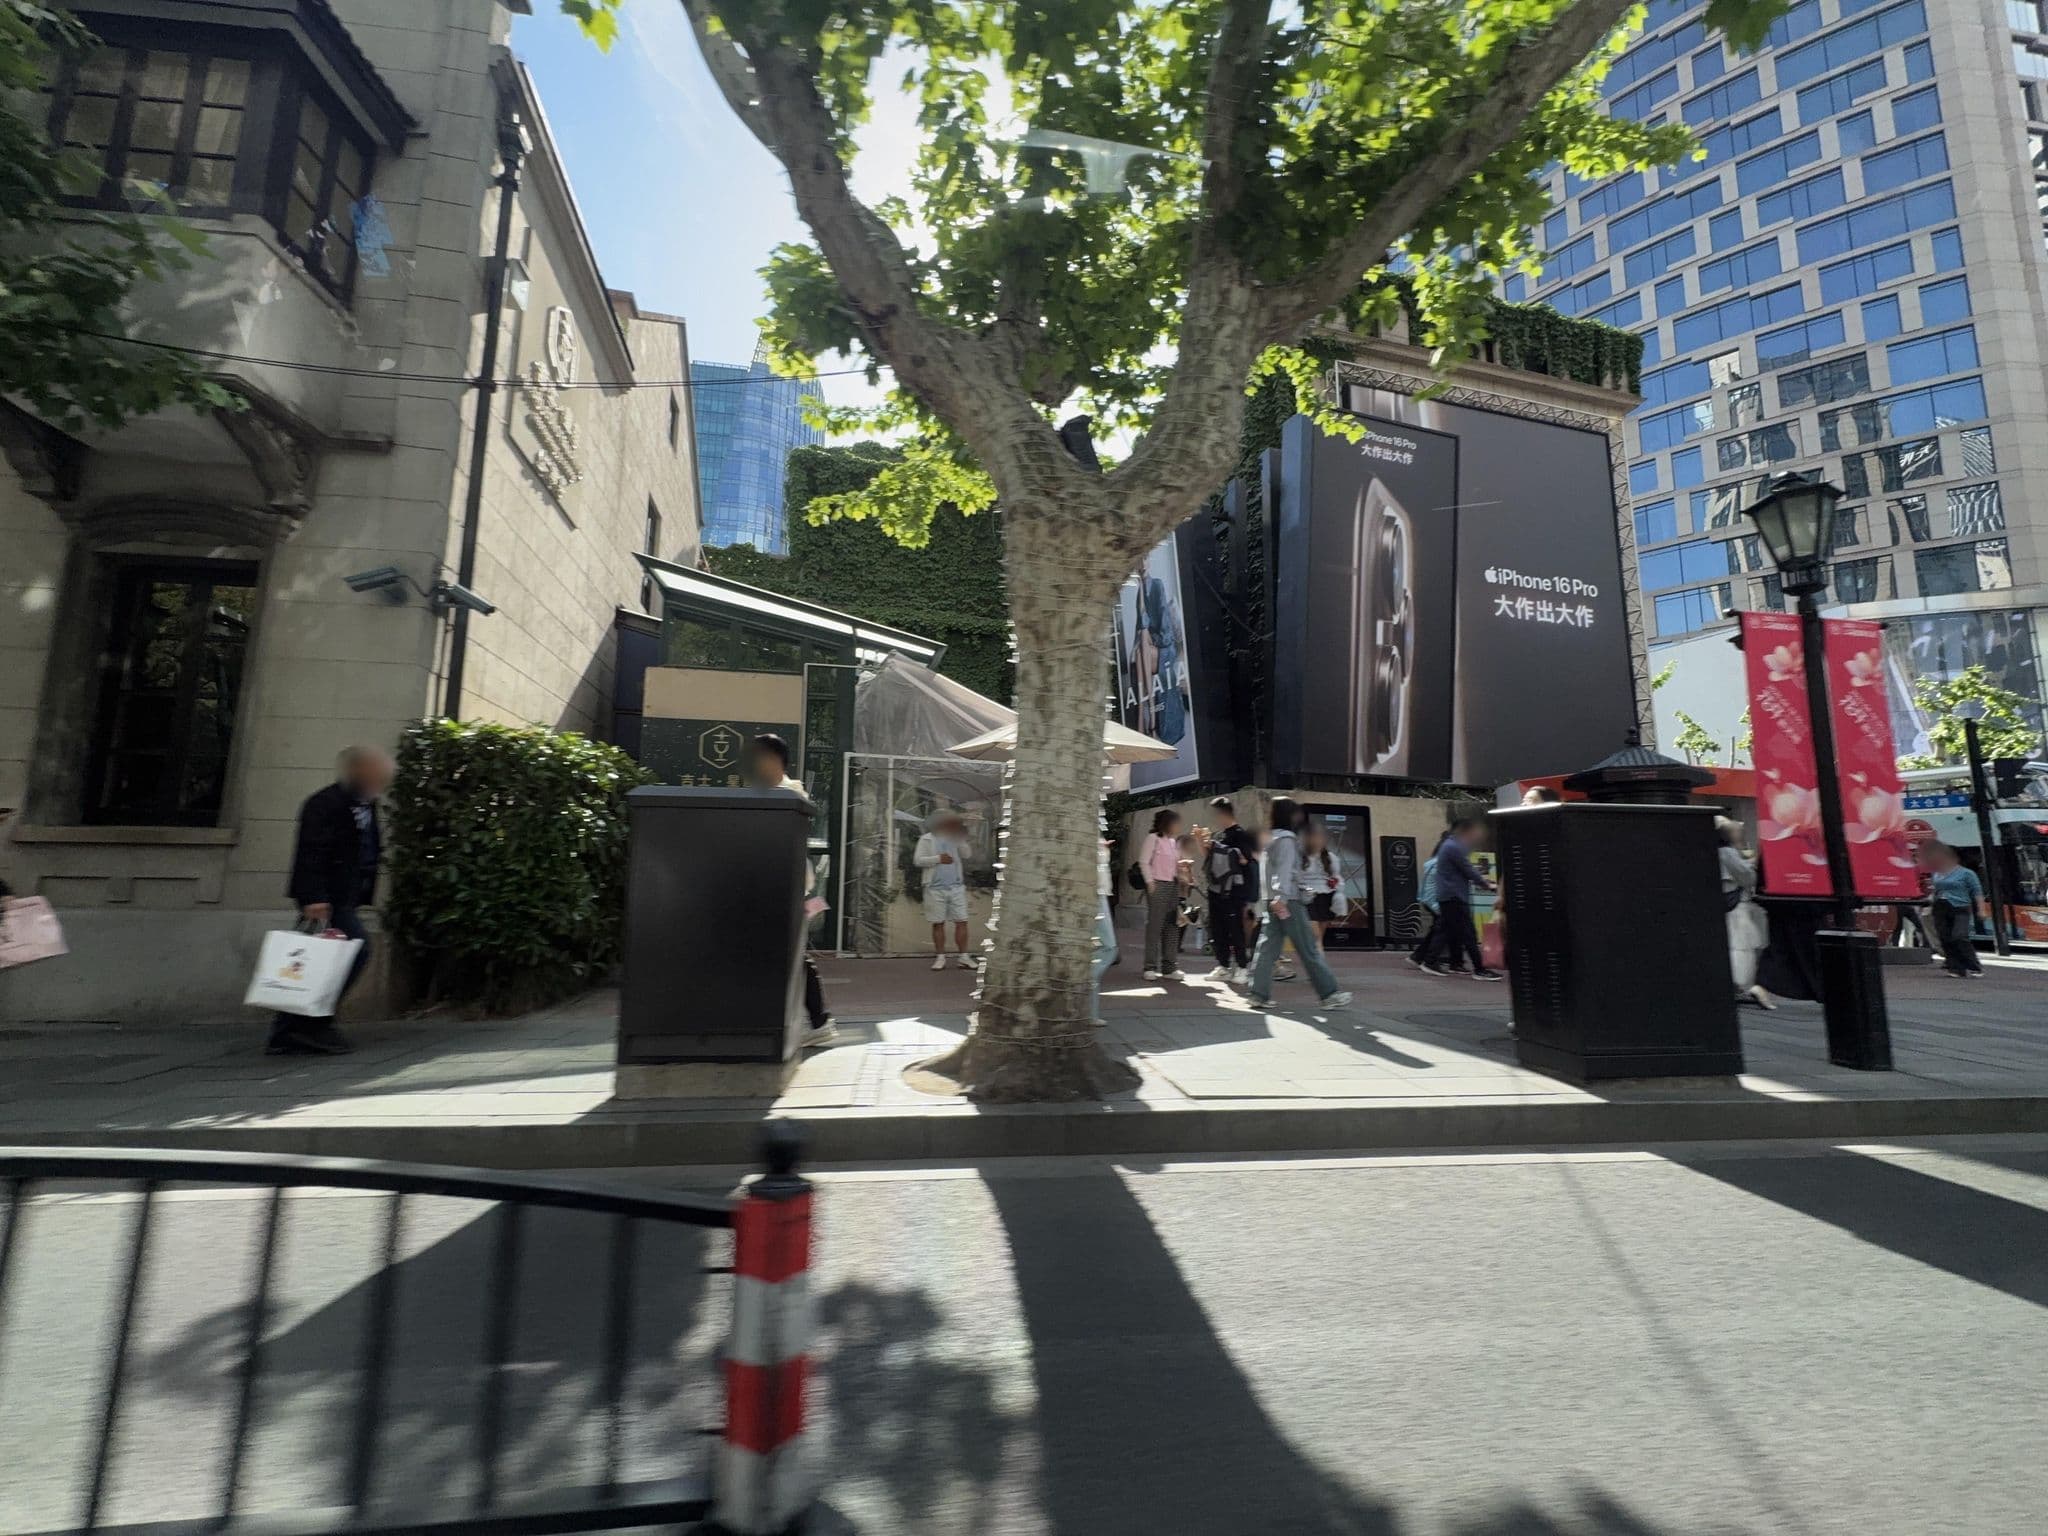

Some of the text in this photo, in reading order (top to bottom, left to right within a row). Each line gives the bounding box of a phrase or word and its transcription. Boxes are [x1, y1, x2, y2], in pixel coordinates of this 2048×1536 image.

[1364, 431, 1392, 444] Phone
[1402, 438, 1417, 449] Pro
[1361, 444, 1414, 464] 大作出大作
[1498, 568, 1598, 597] iPhone 16 Pro
[1494, 594, 1594, 628] 大作出大作
